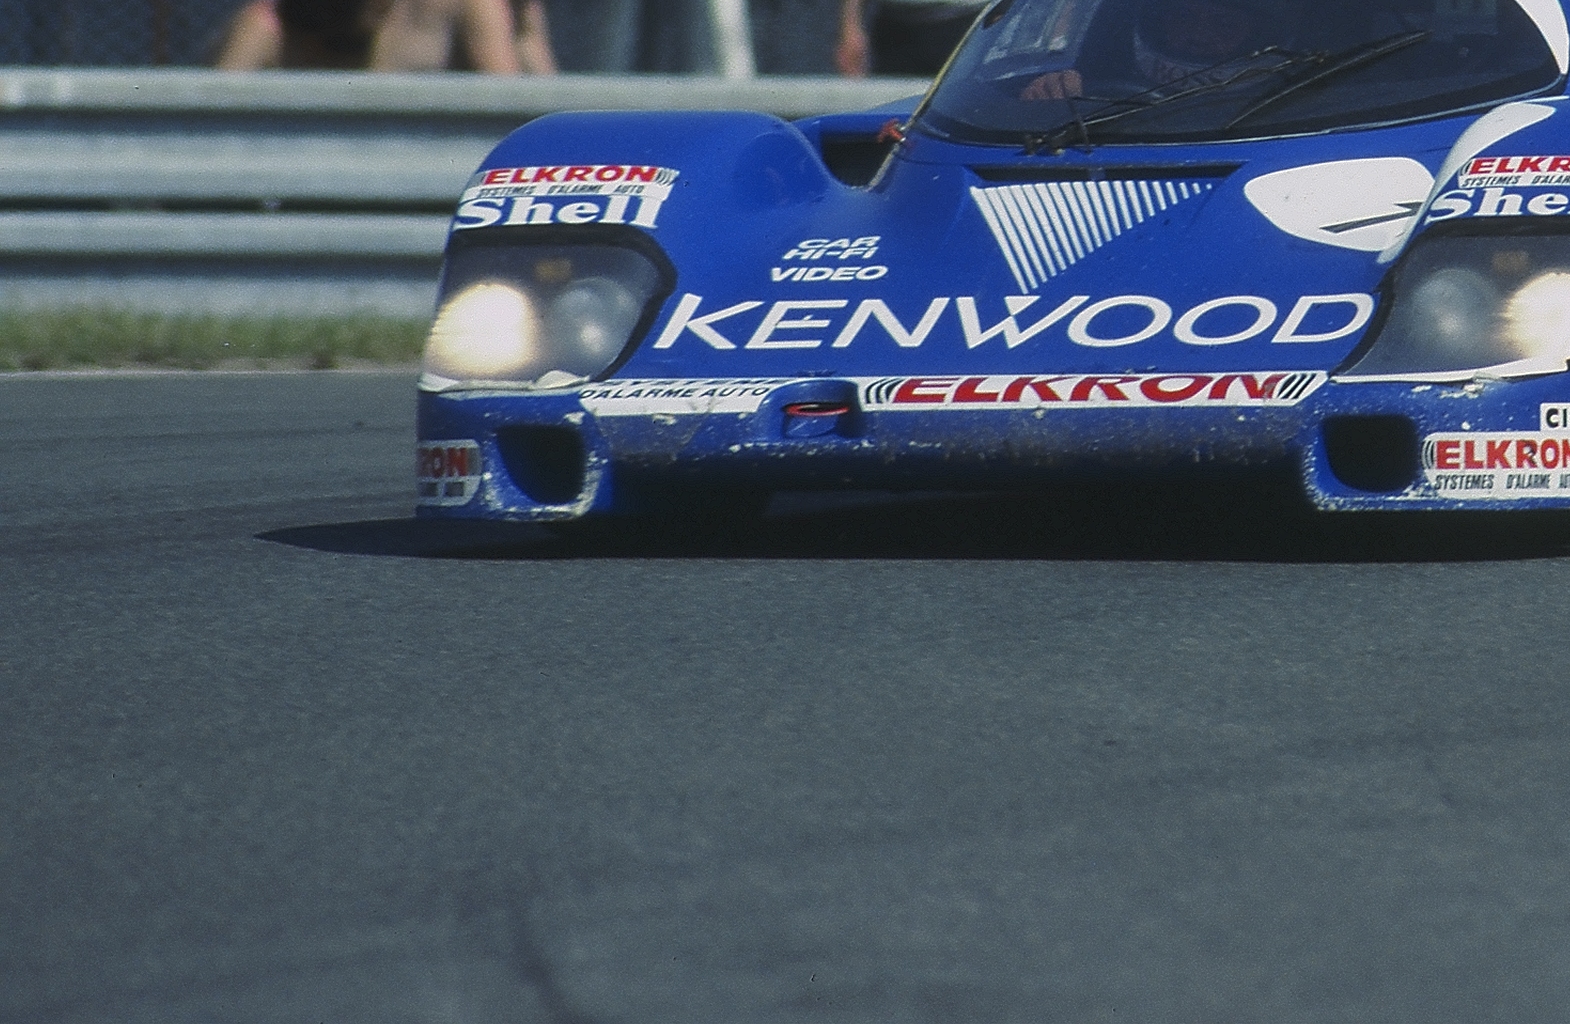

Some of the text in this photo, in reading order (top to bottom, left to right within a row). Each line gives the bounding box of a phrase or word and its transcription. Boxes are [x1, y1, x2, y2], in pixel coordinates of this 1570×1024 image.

[483, 165, 658, 186] ELKRON
[452, 195, 659, 231] Shell
[797, 235, 881, 249] CAR
[781, 246, 880, 260] HI-FI
[770, 265, 889, 282] VIDEO
[652, 292, 1374, 350] KENWOOD
[699, 386, 770, 398] AUTO
[892, 373, 1287, 403] ELKRON
[1434, 473, 1495, 490] SYSTEMES
